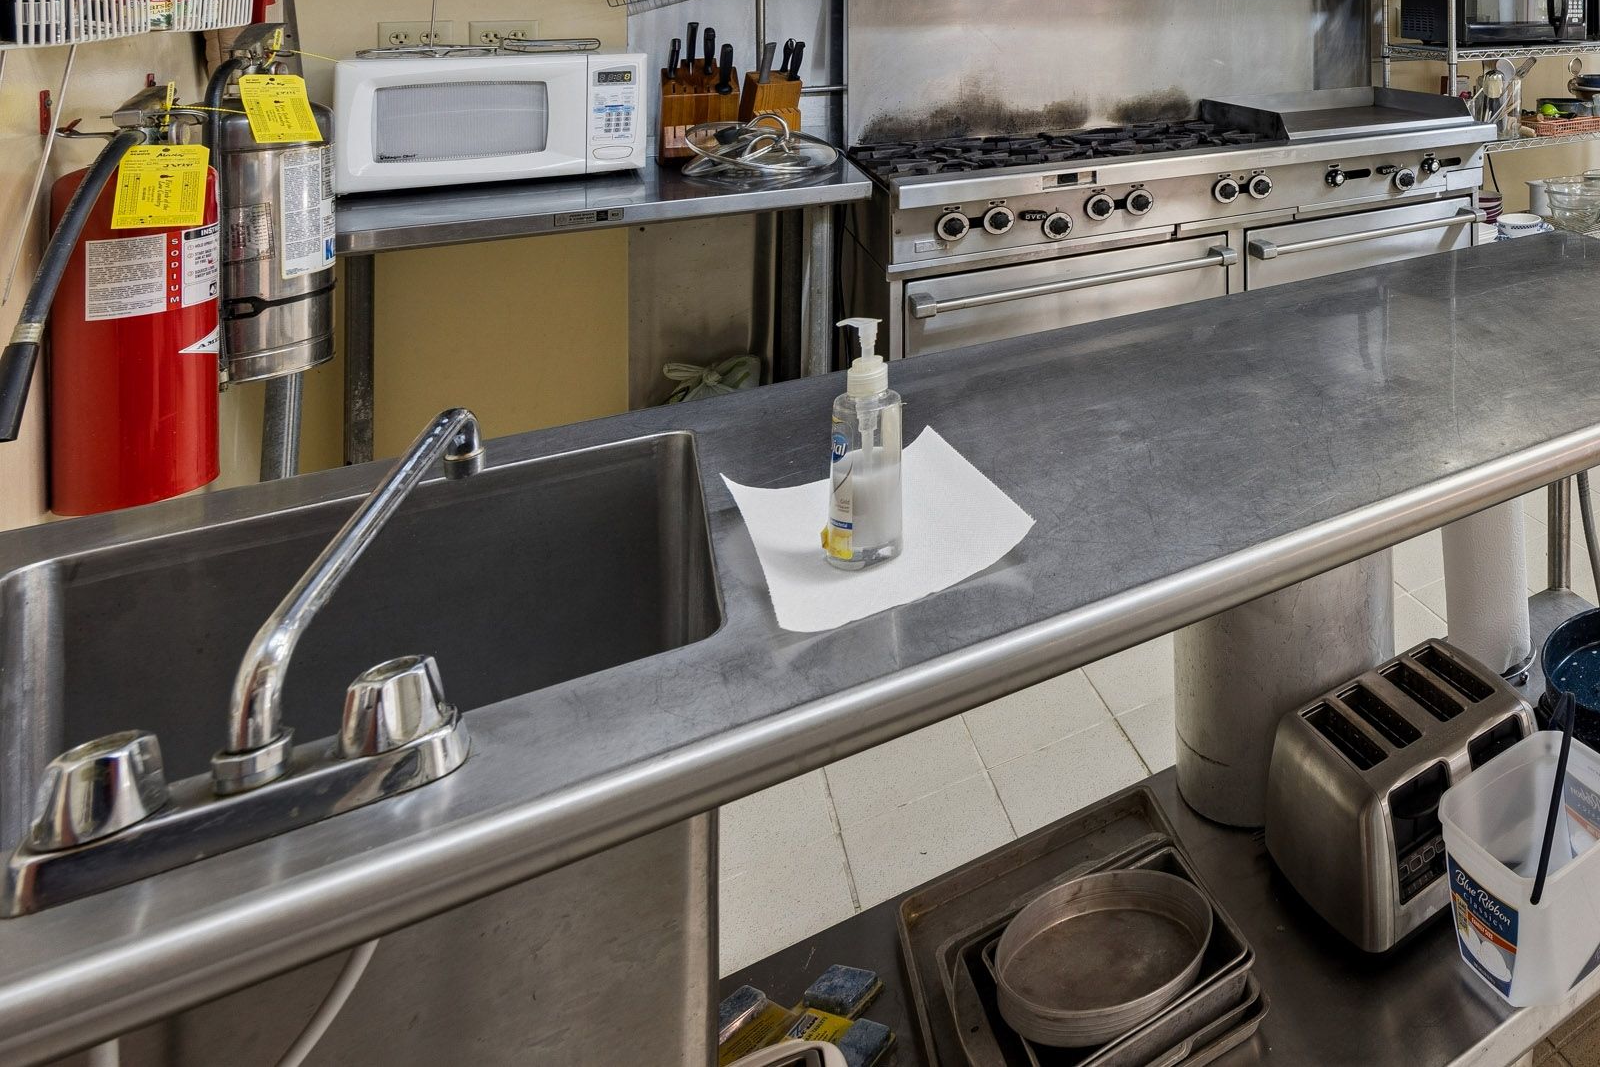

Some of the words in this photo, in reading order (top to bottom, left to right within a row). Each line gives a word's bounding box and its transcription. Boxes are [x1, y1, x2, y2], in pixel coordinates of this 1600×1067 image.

[170, 238, 180, 303] SODIUM
[831, 439, 847, 456] ial
[1455, 869, 1477, 897] Blue
[1477, 889, 1512, 927] Ribbon
[1463, 892, 1504, 931] Classics
